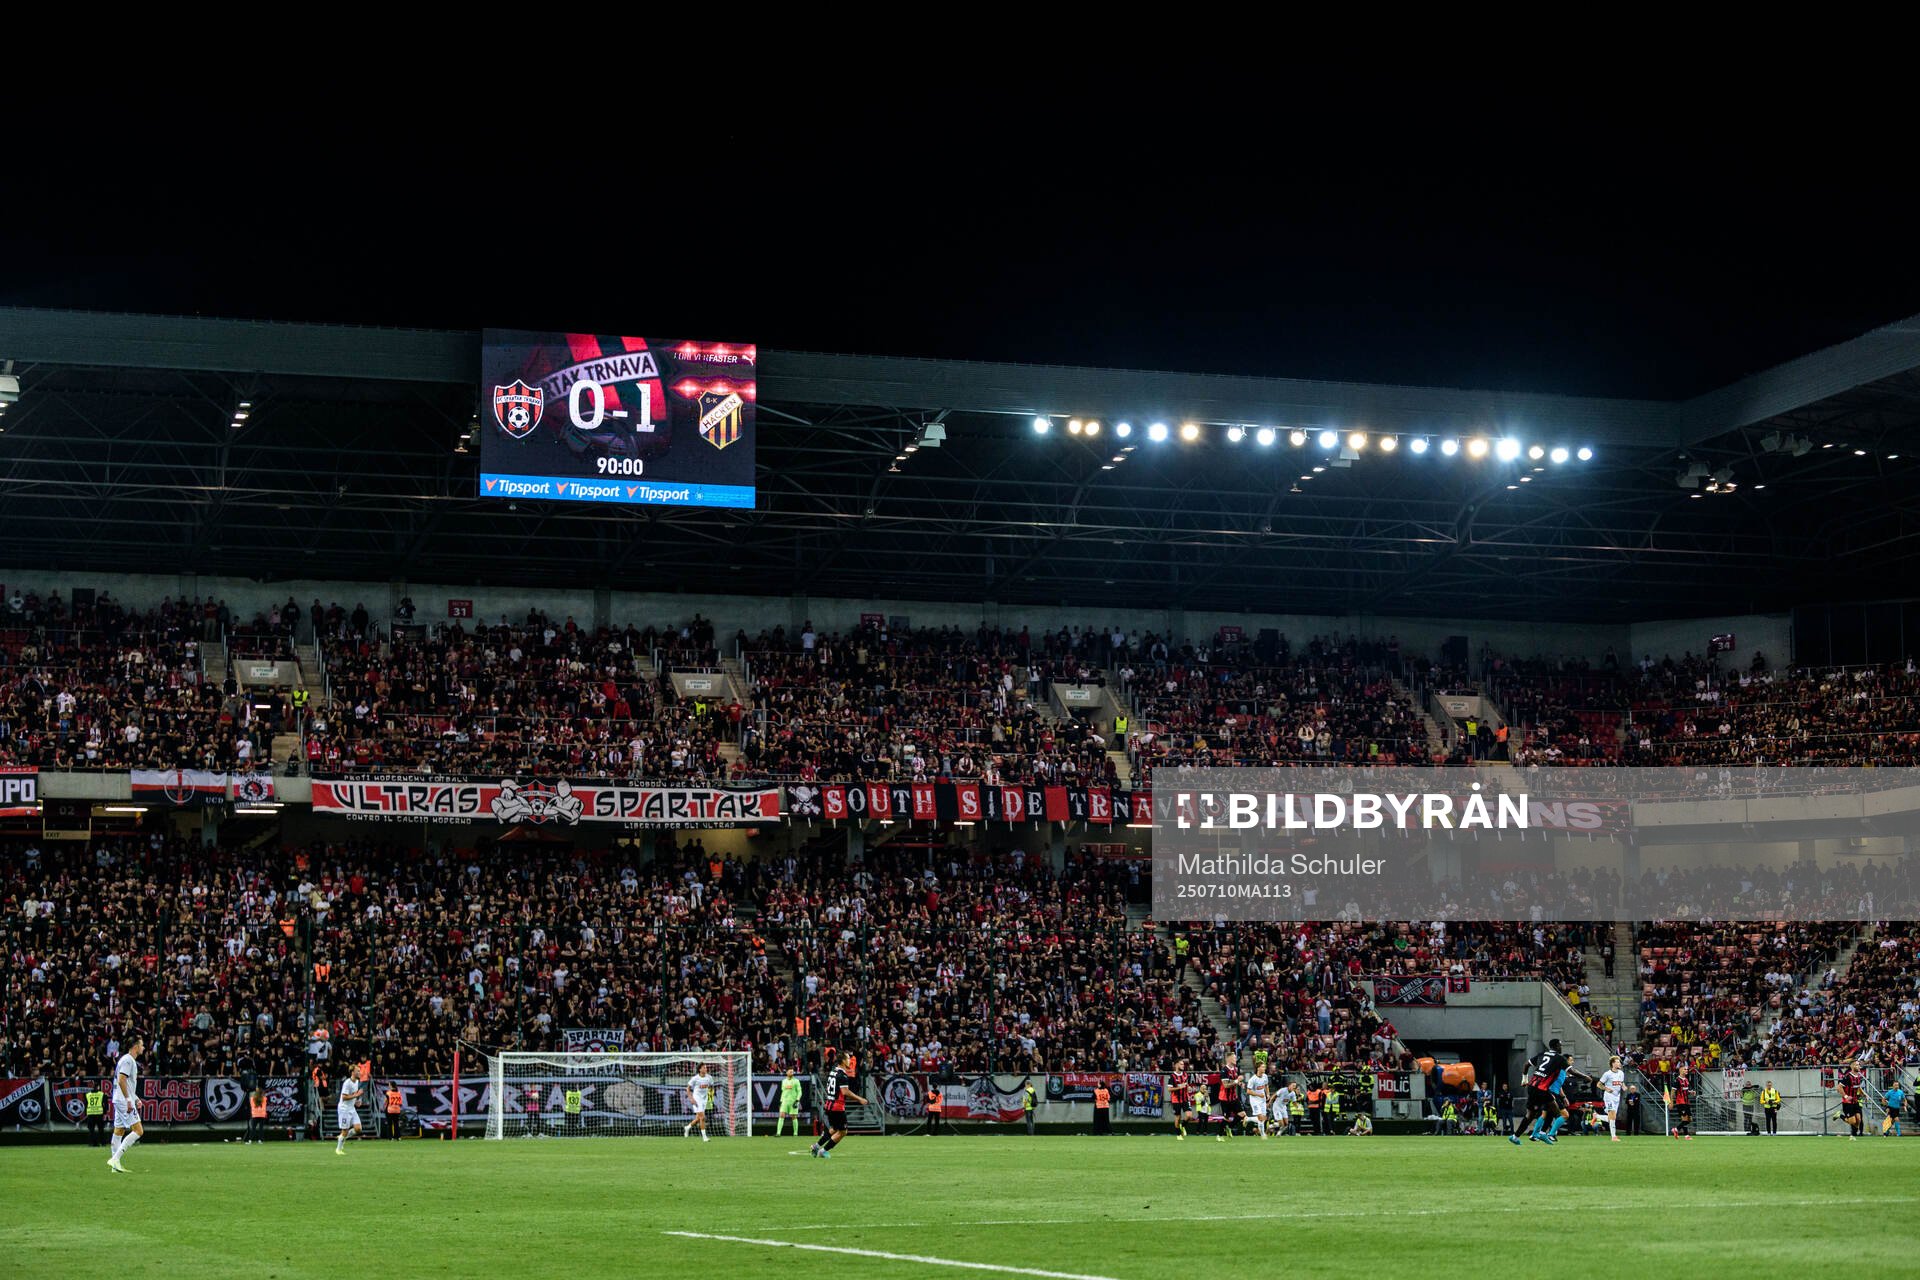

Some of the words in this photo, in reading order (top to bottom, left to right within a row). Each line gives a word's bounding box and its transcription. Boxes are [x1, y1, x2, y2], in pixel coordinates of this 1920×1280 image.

[709, 354, 738, 363] FASTER
[584, 356, 654, 382] TRNAVA
[597, 457, 643, 475] 90:00
[499, 480, 550, 495] Tipsport
[570, 483, 620, 498] Tipsport
[640, 486, 690, 502] Tipsport
[453, 607, 467, 617] 31
[331, 785, 479, 813] ULTRAS
[595, 791, 761, 818] SPARTAK
[826, 787, 935, 813] SOUTH
[962, 790, 1043, 818] SIDE
[1070, 792, 1196, 820] TRNAVA
[346, 813, 380, 821] CONTRO
[1463, 800, 1603, 829] FNS
[569, 1030, 622, 1041] SPARTAK
[1538, 1055, 1551, 1072] 2
[1129, 1073, 1161, 1086] SPARTAK
[1189, 1073, 1209, 1085] ANS
[11, 1080, 43, 1100] REBELS
[144, 1079, 200, 1099] BLACK
[90, 1097, 99, 1106] 87
